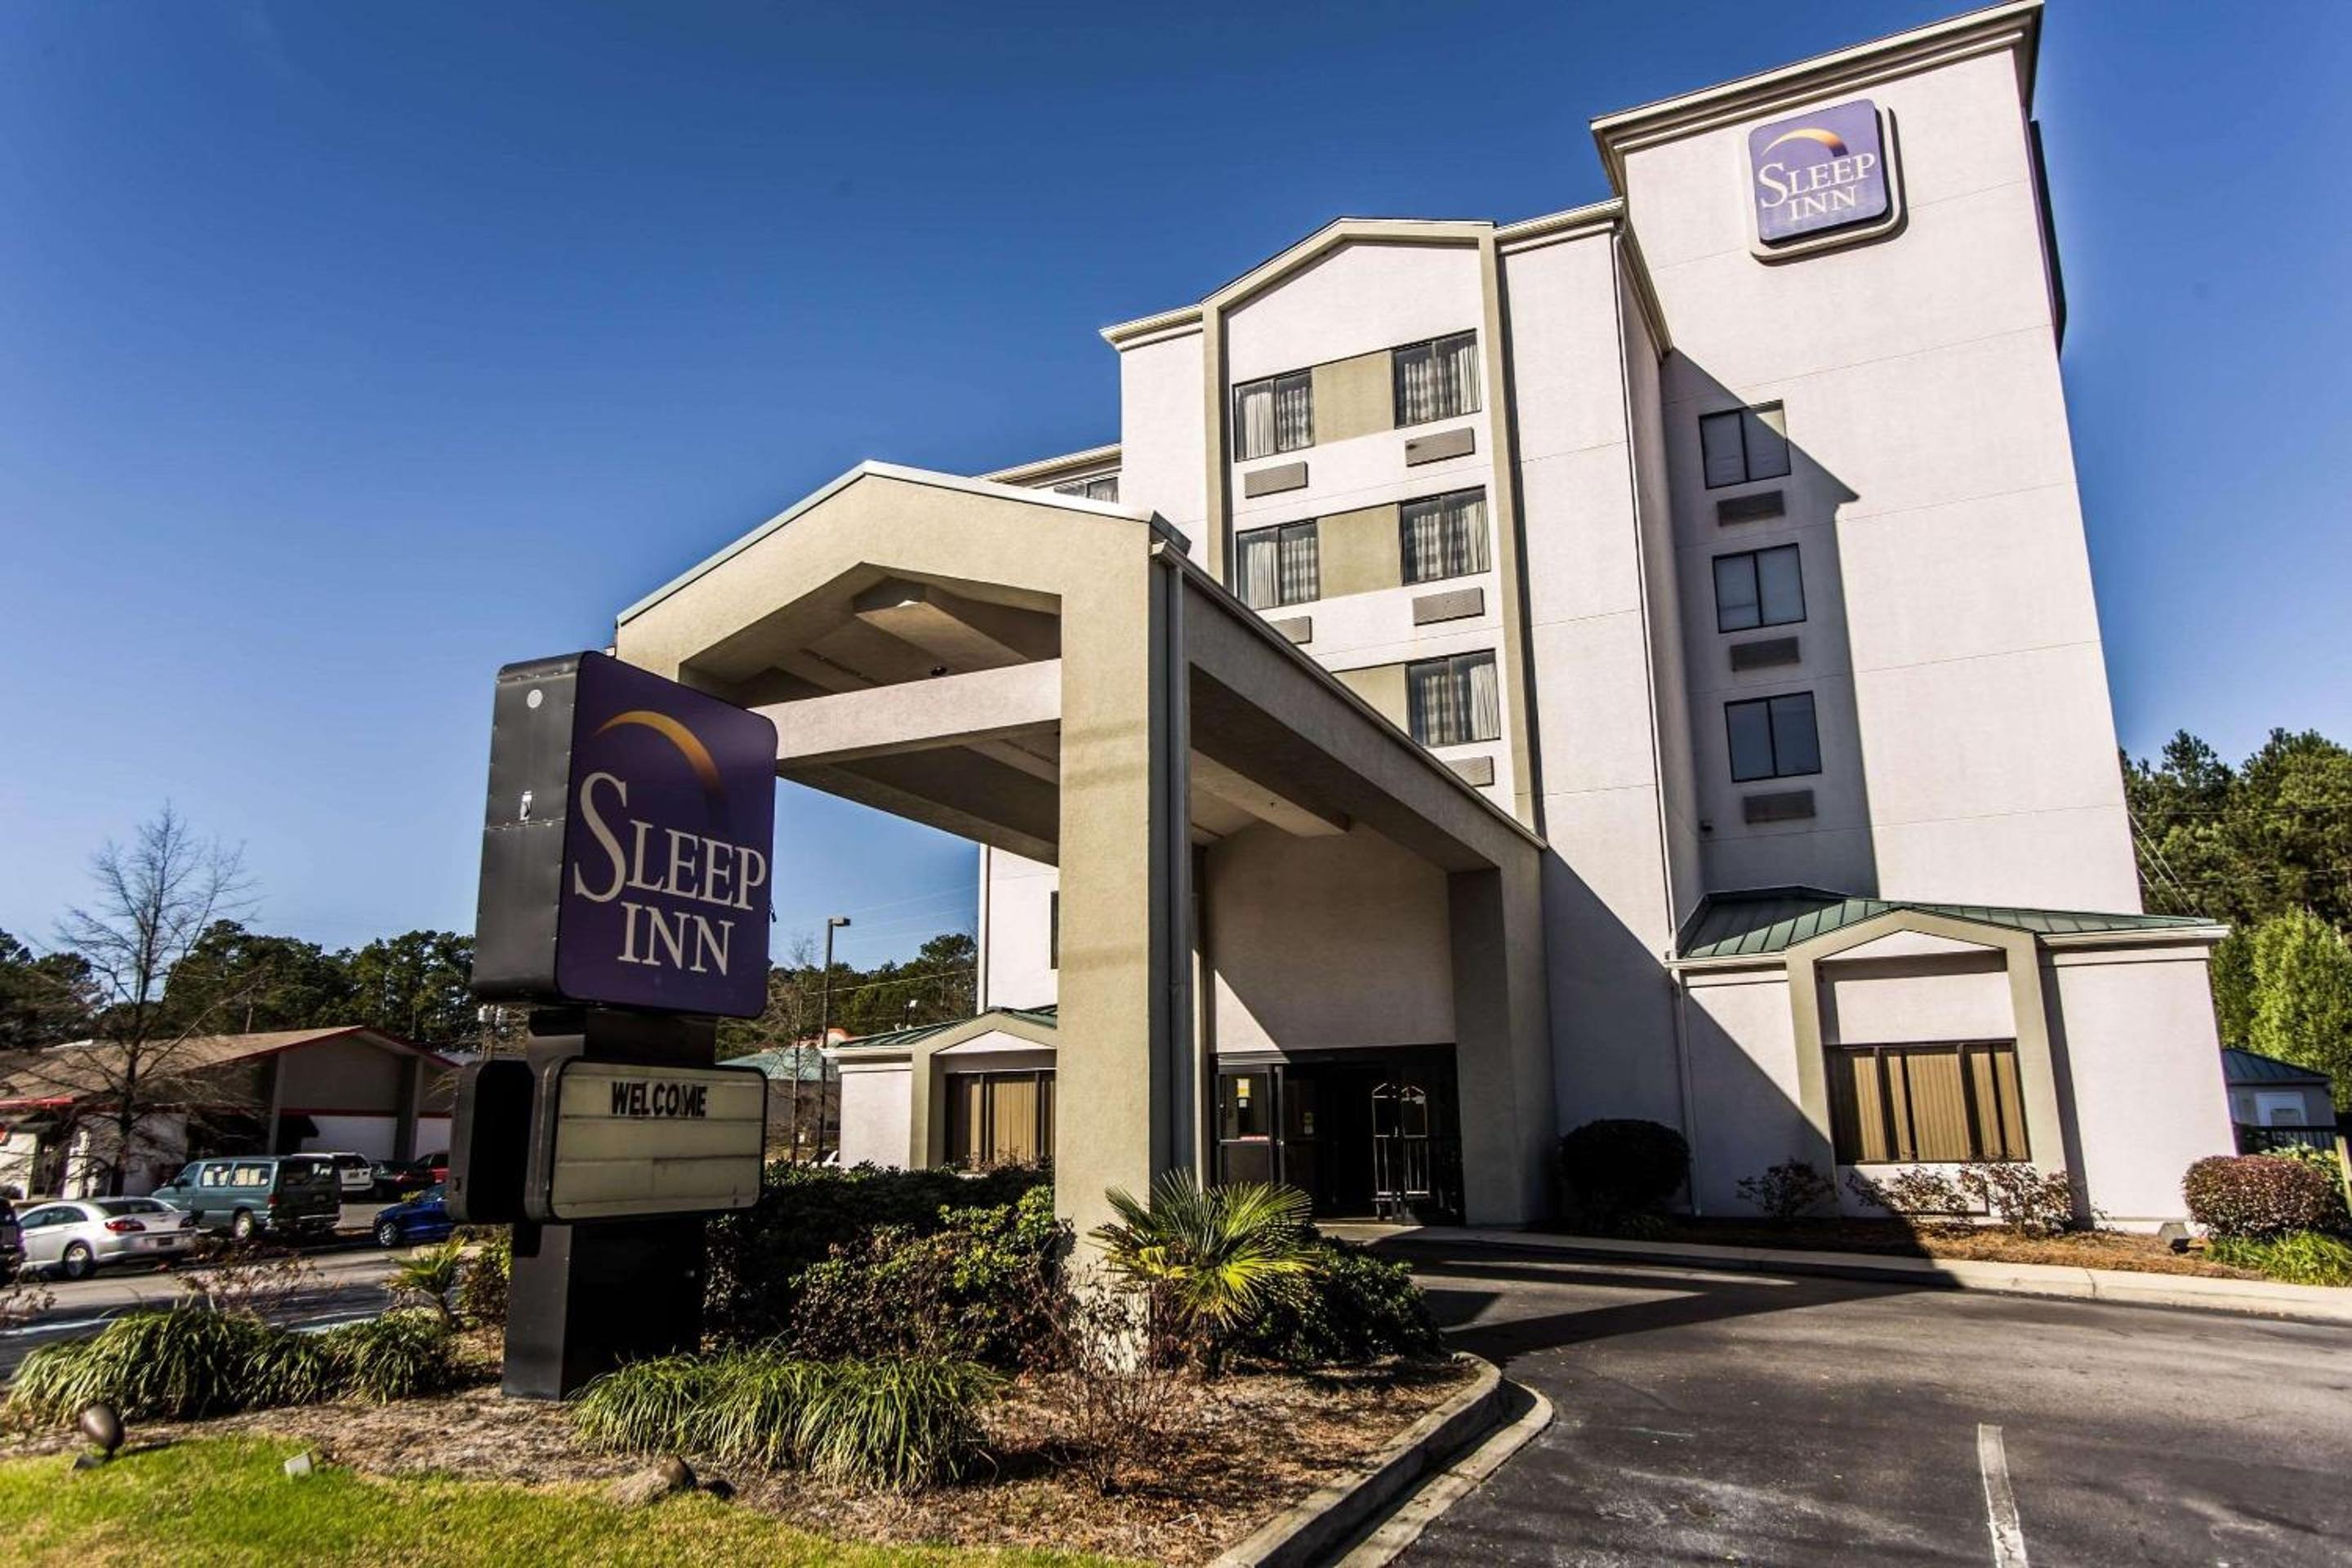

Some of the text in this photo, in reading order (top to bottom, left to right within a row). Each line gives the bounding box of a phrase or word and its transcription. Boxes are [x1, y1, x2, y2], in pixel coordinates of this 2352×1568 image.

[1758, 153, 1875, 208] SLEEP
[1787, 185, 1857, 221] INN
[574, 772, 766, 911] SLEEP
[617, 901, 734, 976] INN
[612, 1081, 707, 1117] WELCOME
